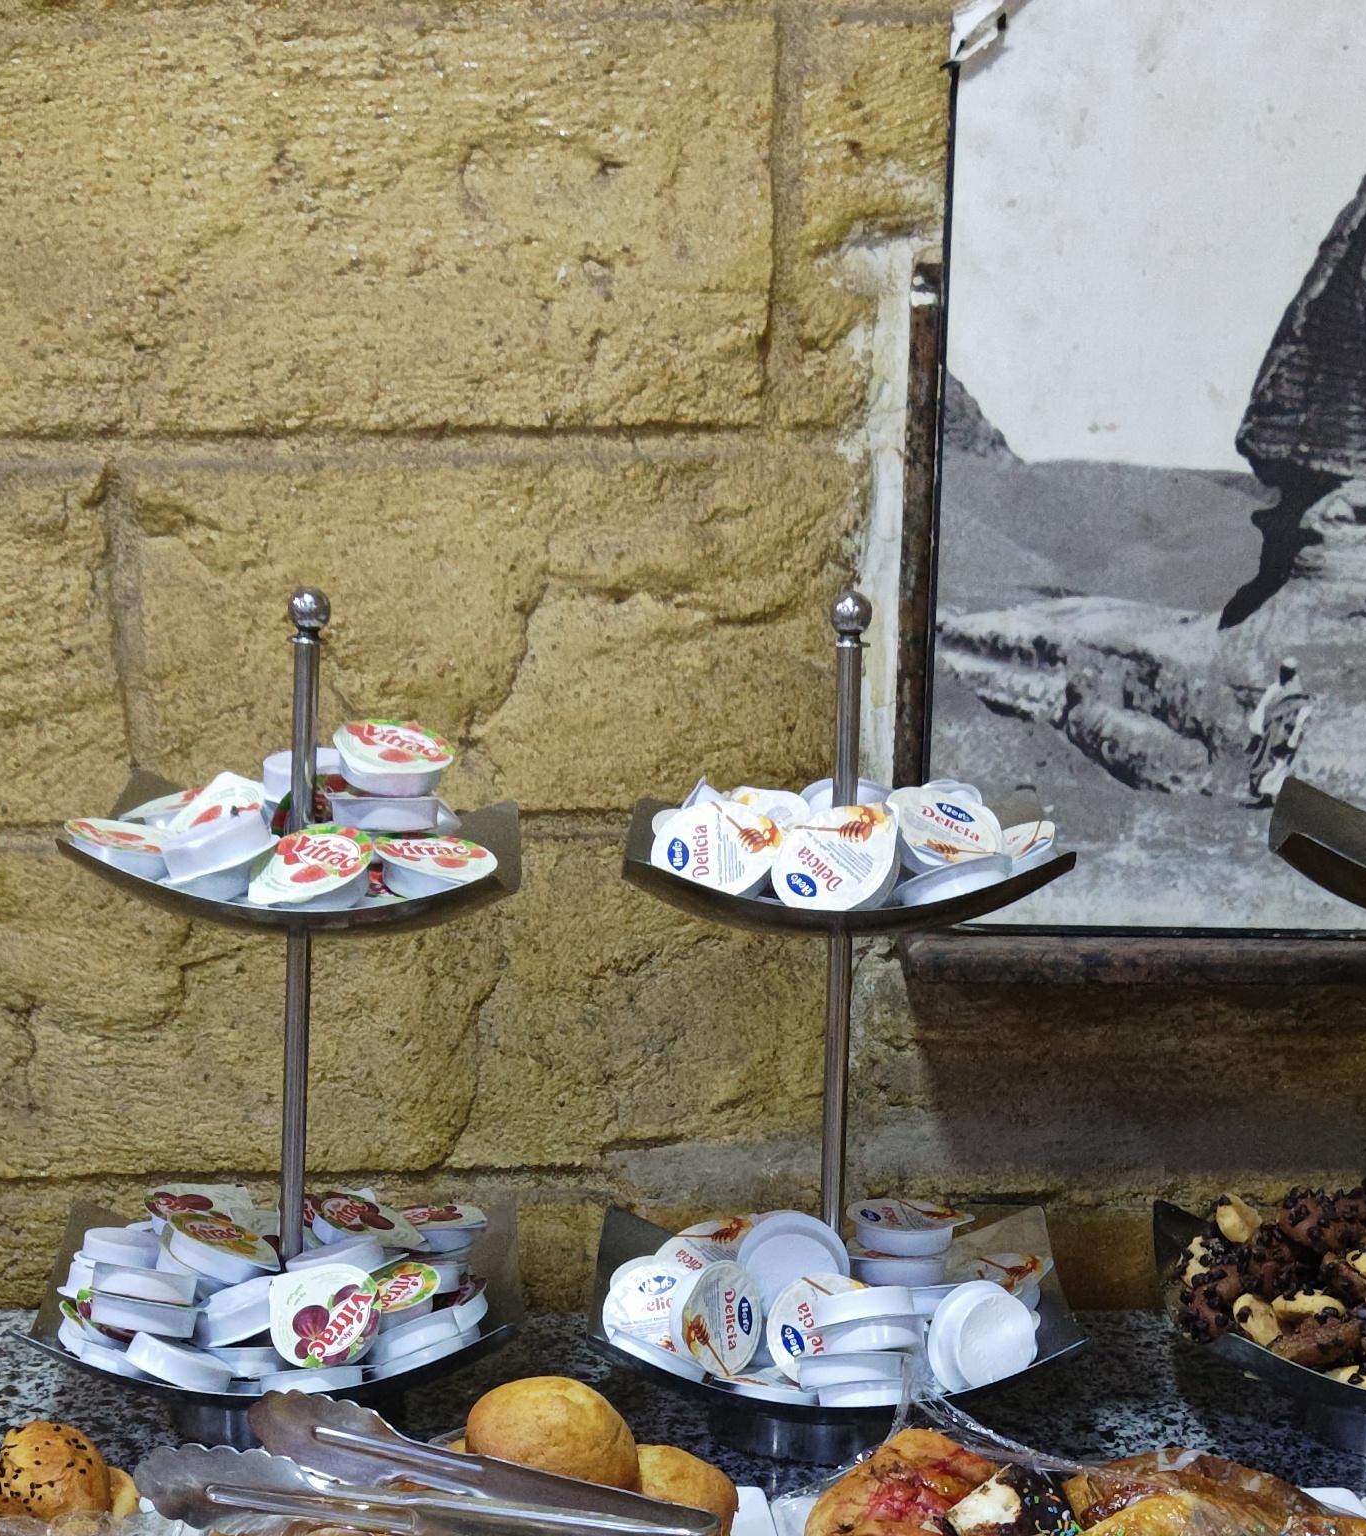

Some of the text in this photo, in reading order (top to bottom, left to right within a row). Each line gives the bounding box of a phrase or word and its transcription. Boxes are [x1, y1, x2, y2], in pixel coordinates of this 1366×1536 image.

[364, 722, 441, 758] Vitrac
[921, 805, 980, 842] Delicia
[942, 803, 971, 822] Hero
[294, 834, 360, 870] Vitrac
[388, 841, 469, 858] Vitrac
[692, 824, 710, 878] Delicia
[790, 873, 814, 896] Hero
[797, 846, 843, 892] Delicia
[309, 1293, 373, 1359] Vitrac
[723, 1287, 738, 1351] Delicia
[784, 1327, 802, 1356] Hero
